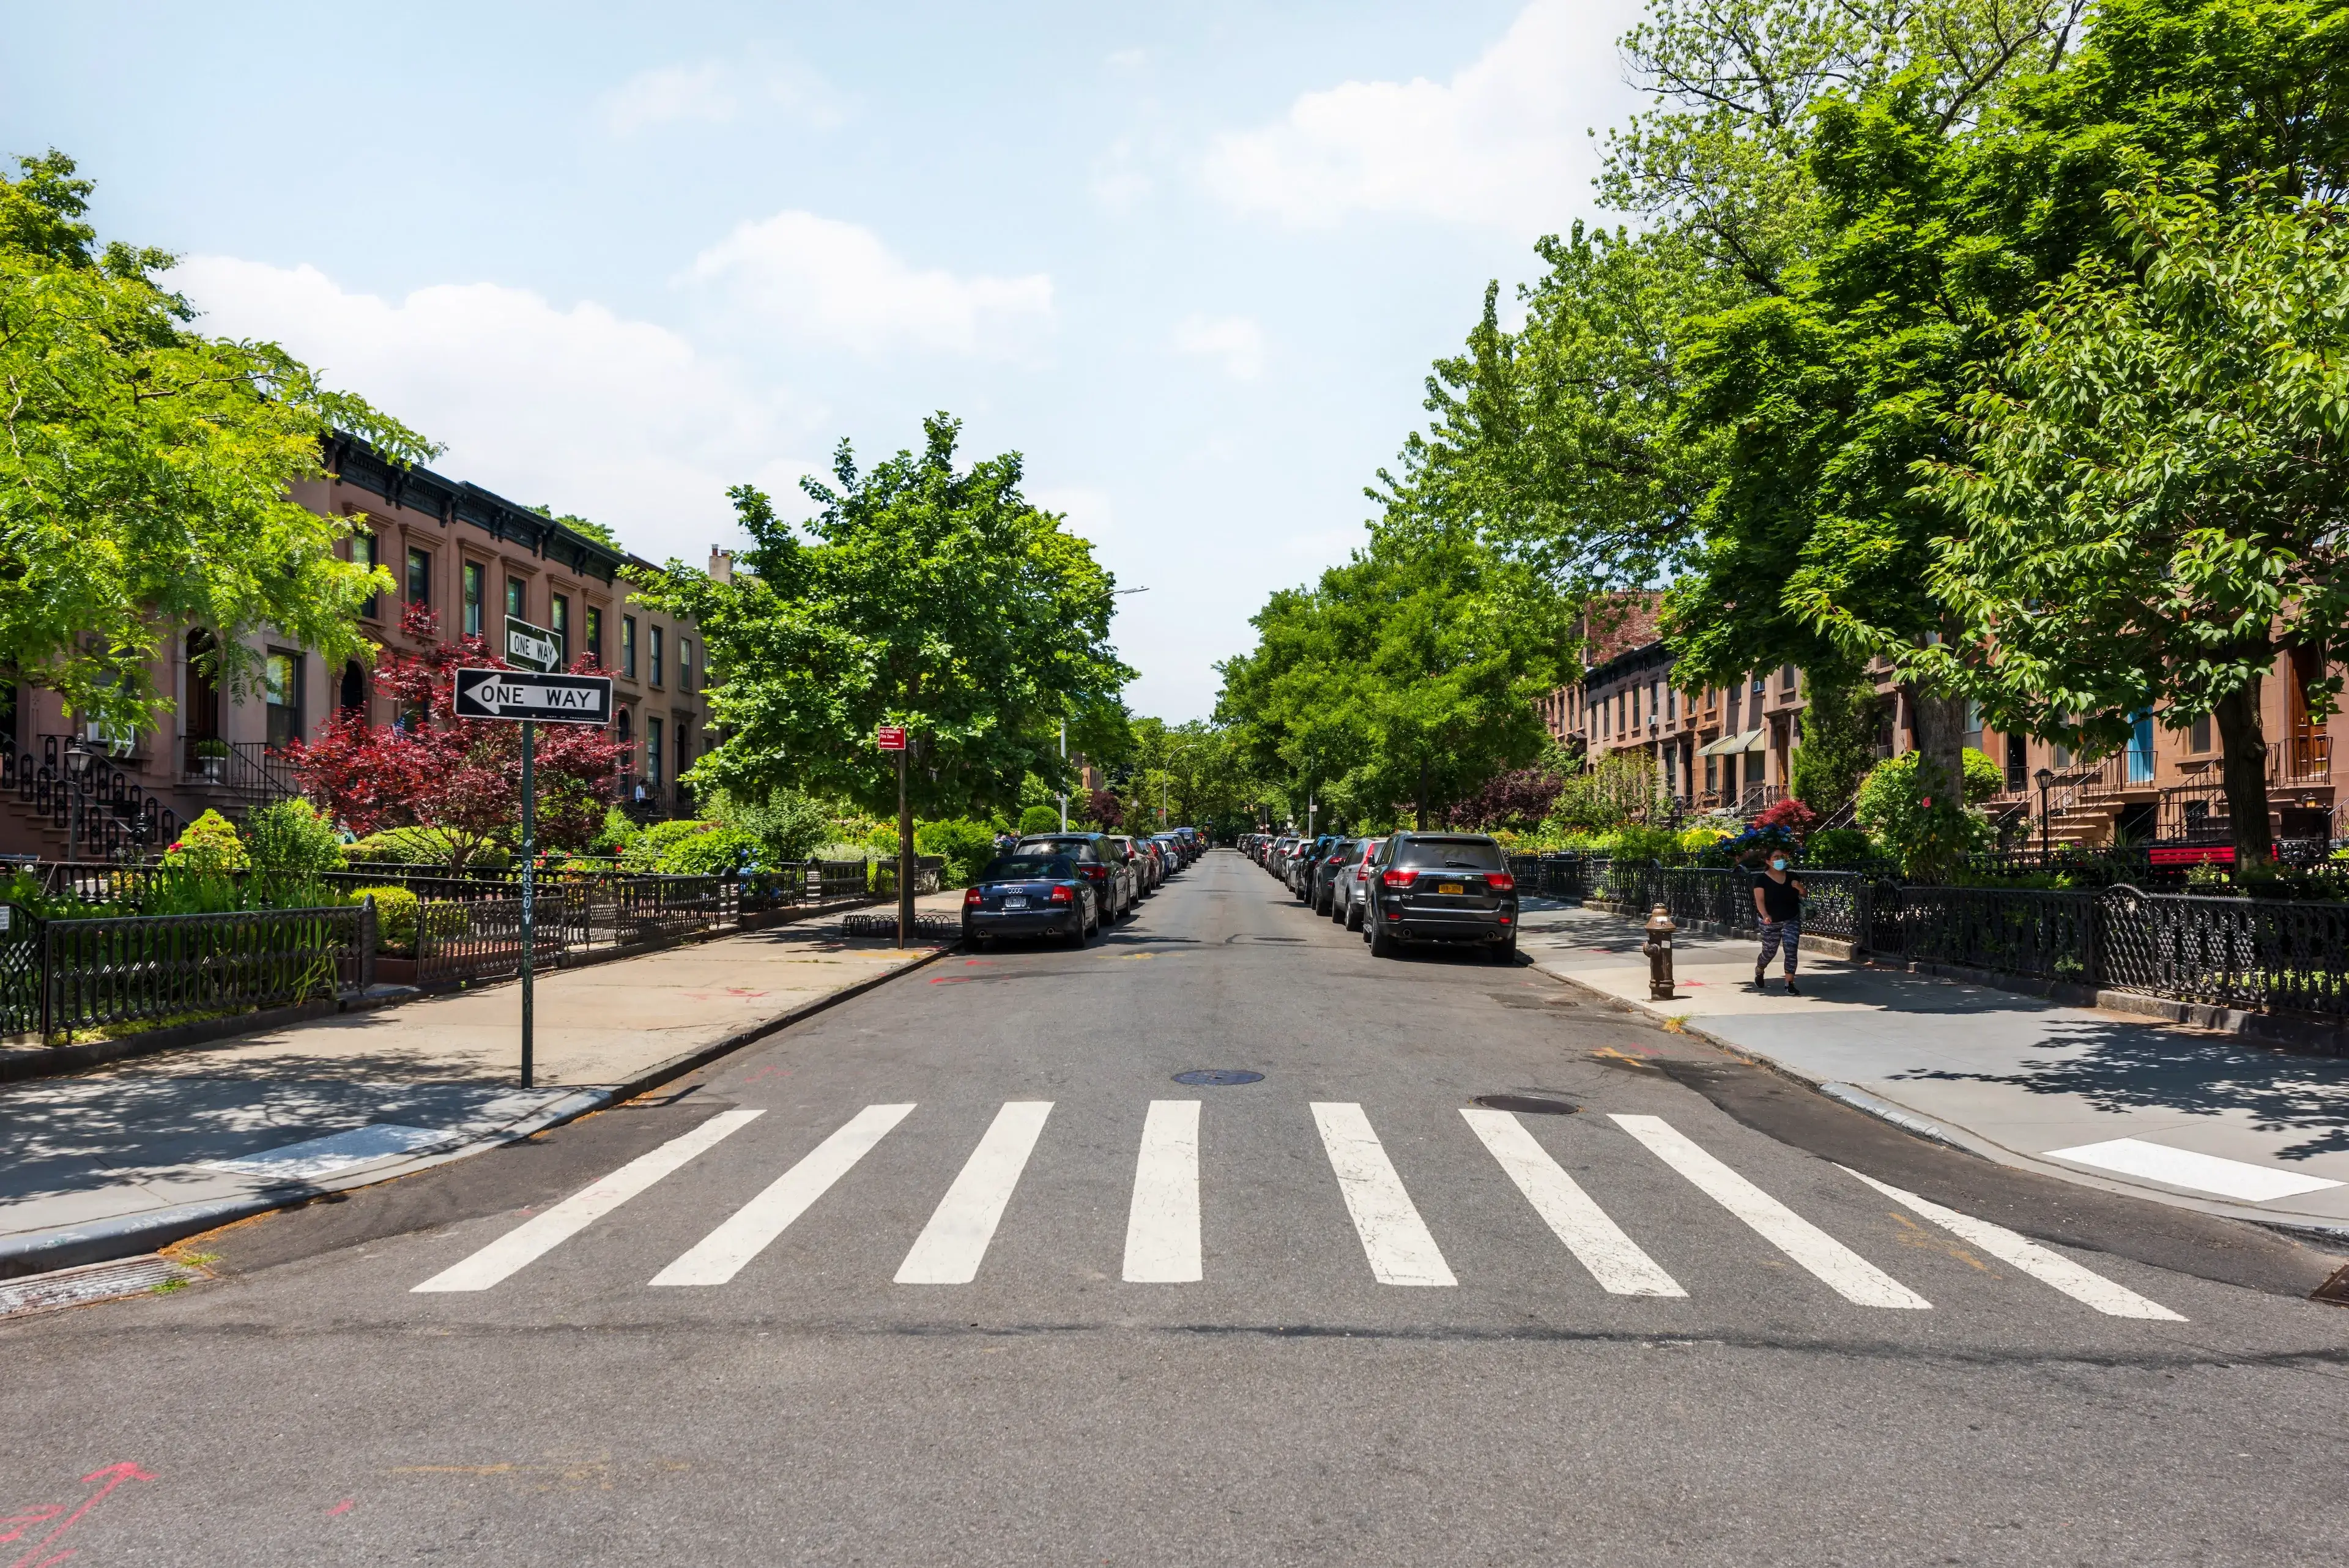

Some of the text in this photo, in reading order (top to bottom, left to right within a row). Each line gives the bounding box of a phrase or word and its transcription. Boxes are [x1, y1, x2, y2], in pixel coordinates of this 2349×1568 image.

[514, 634, 553, 662] ONE WAY
[481, 685, 591, 708] ONE WAY
